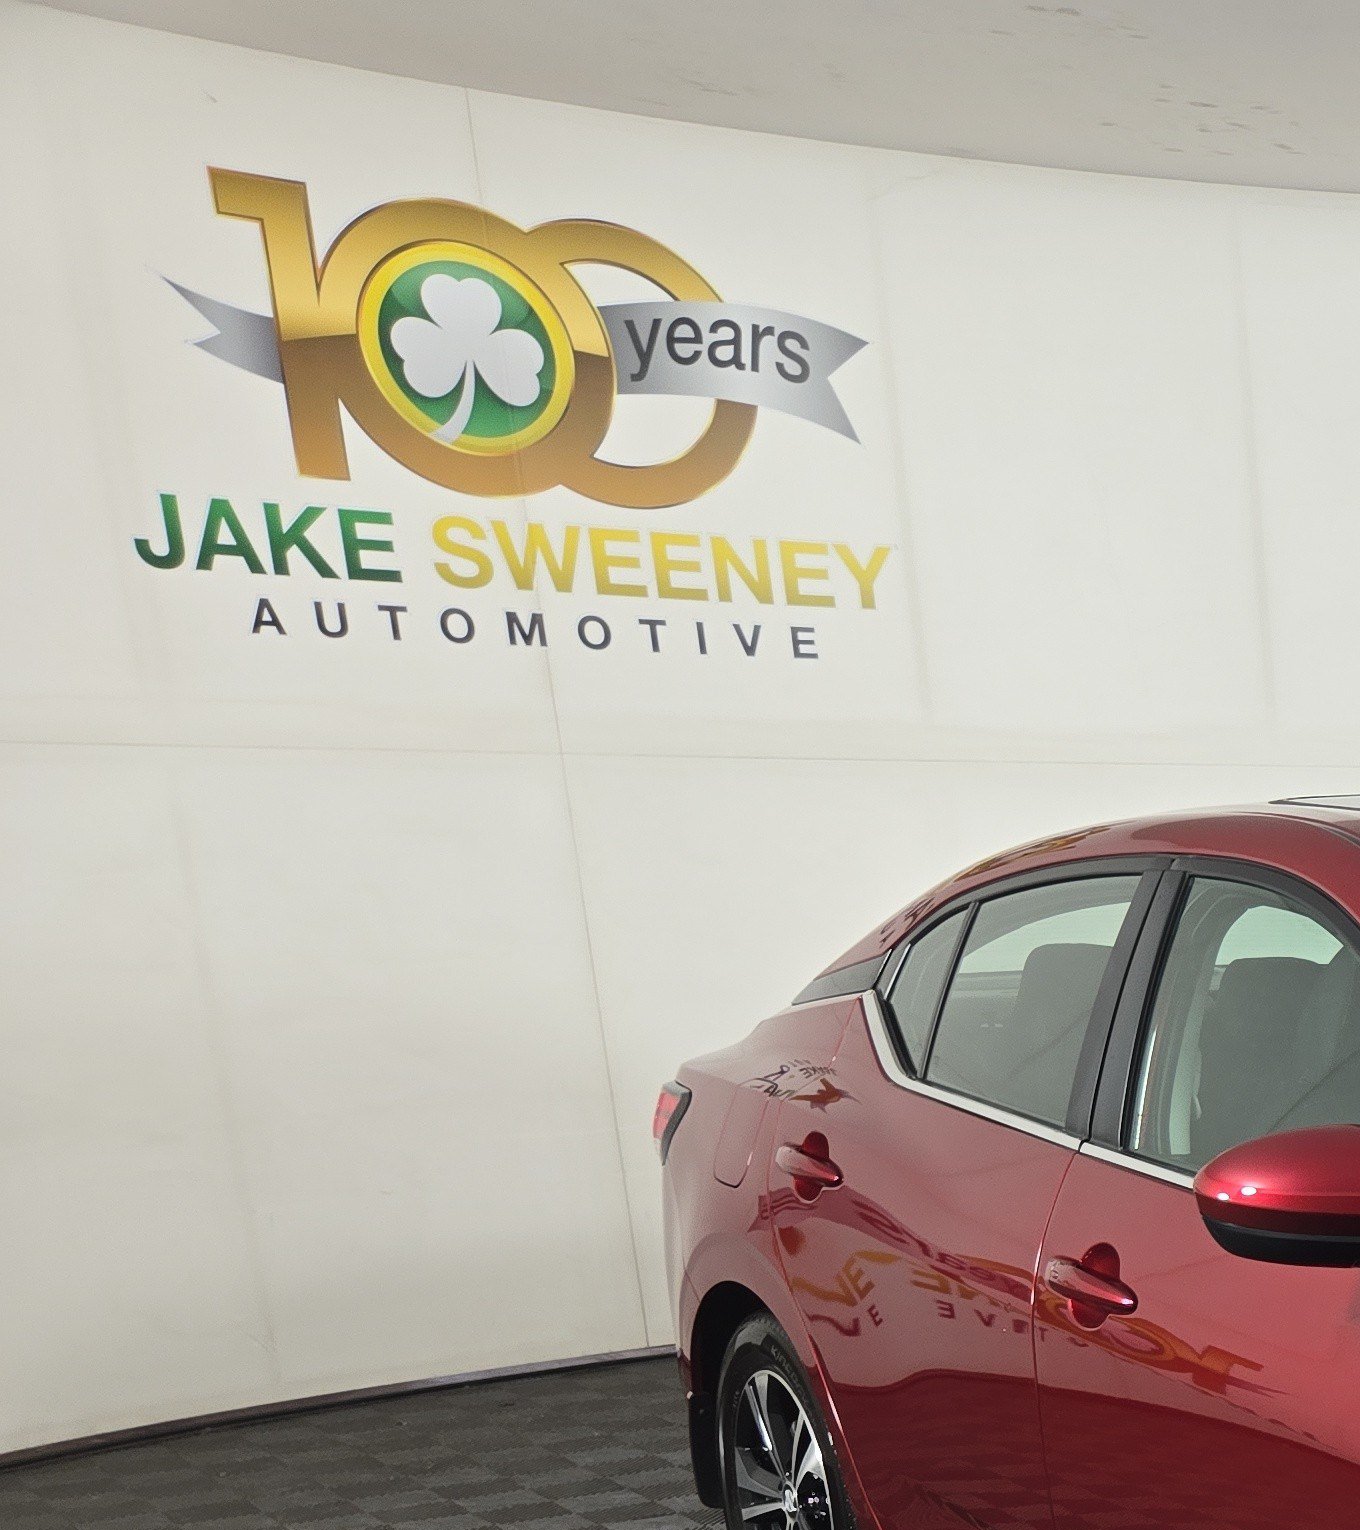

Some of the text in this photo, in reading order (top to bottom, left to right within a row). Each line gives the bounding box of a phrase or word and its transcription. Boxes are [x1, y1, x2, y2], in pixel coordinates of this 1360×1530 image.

[207, 165, 811, 509] 100 years
[133, 490, 891, 610] JAKE SWEENEY
[251, 597, 820, 660] AUTOMOTIVE
